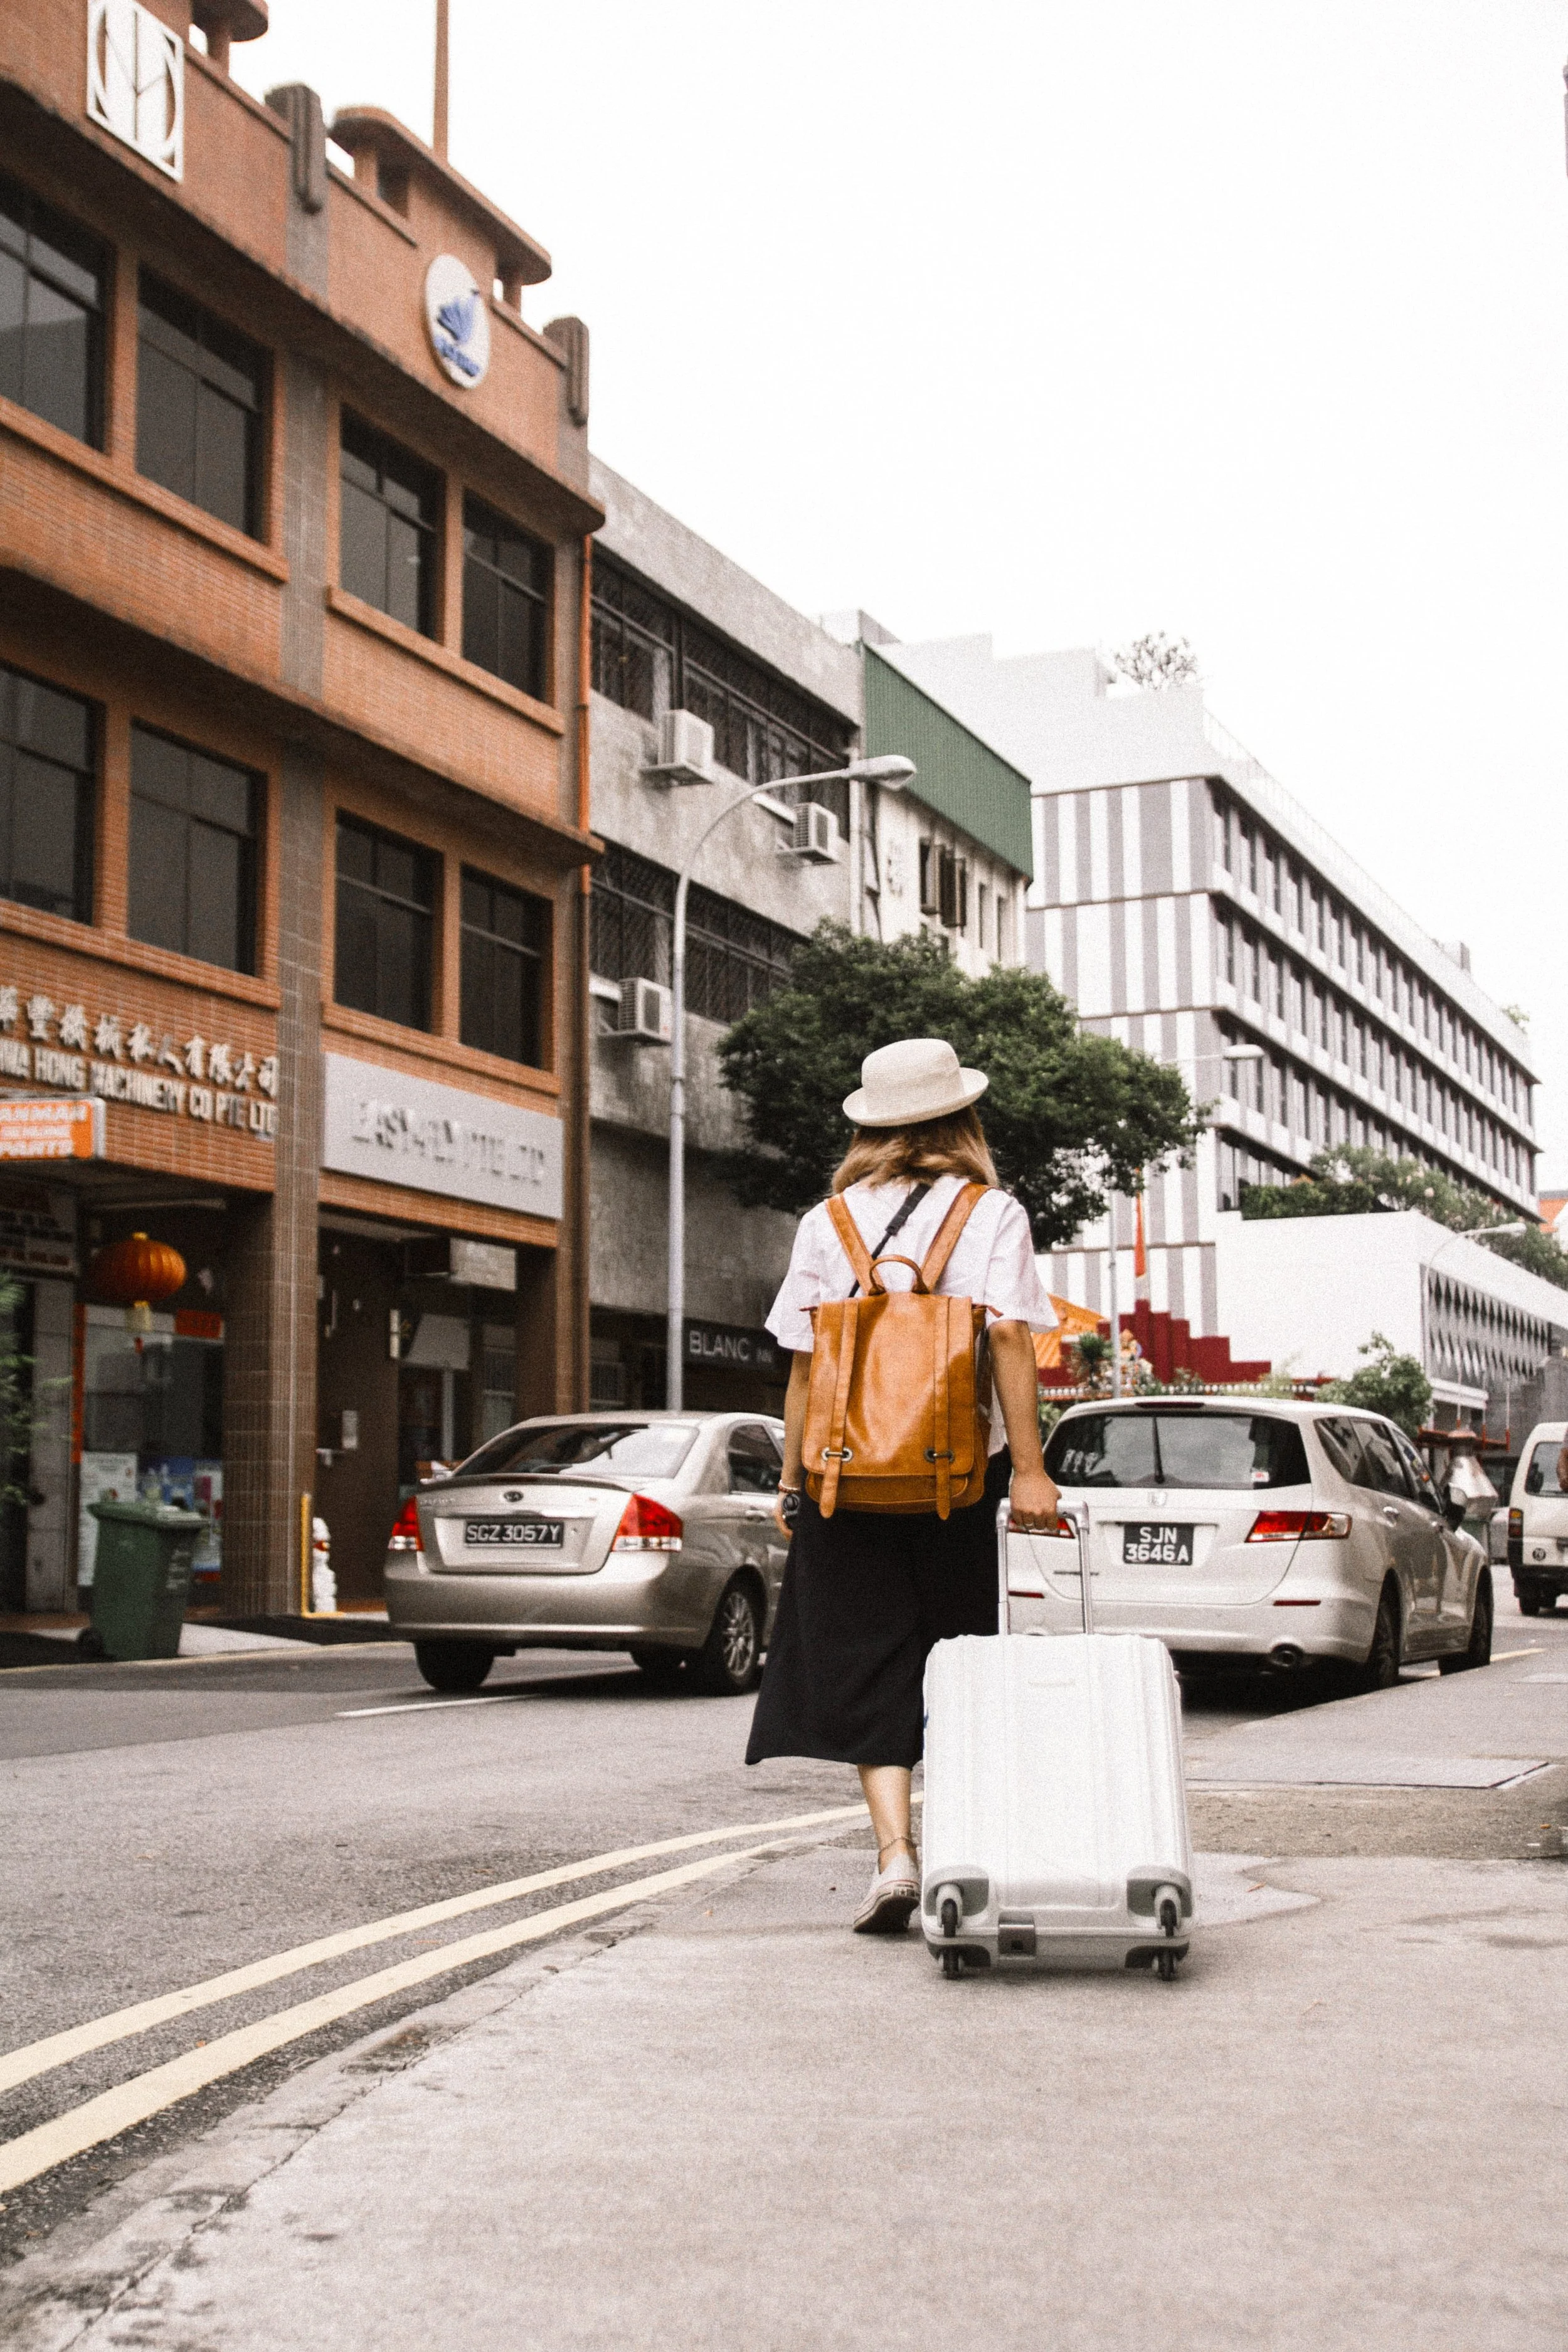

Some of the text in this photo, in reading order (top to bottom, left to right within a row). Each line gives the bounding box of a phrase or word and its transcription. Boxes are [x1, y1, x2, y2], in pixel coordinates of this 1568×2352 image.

[34, 1045, 86, 1090] HONG
[90, 1061, 186, 1115] MACHINERY
[189, 1084, 213, 1121] CO
[216, 1092, 247, 1130] PTE
[689, 1330, 750, 1362] BLANC
[467, 1524, 560, 1542] SGZ 3057Y
[1140, 1527, 1177, 1544] SJN
[1125, 1543, 1189, 1562] 3646A
